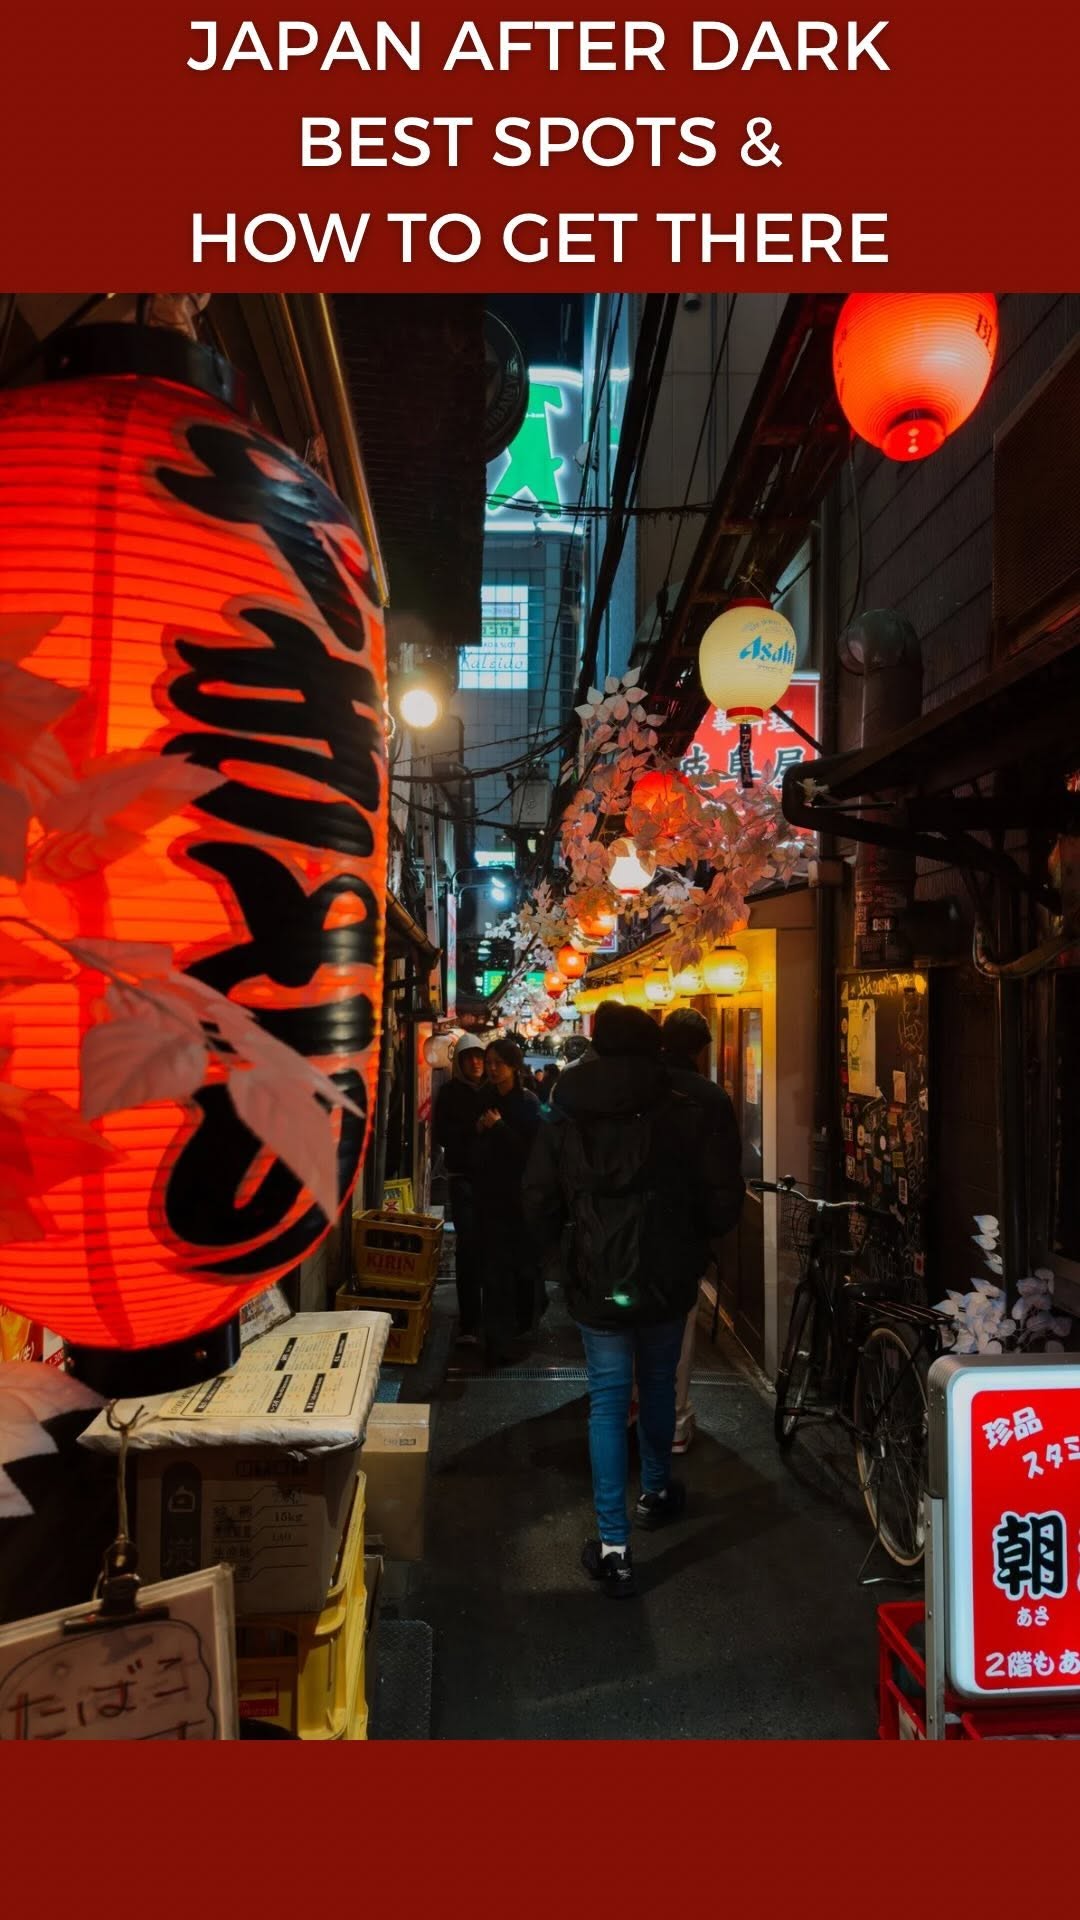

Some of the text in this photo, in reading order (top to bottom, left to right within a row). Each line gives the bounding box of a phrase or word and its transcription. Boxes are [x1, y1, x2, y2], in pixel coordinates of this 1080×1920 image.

[738, 634, 795, 665] Asahi
[367, 1253, 417, 1273] KIRIN
[982, 1406, 1043, 1451] 珍品
[1022, 1436, 1080, 1480] スタミ
[991, 1511, 1080, 1600] 朝
[1016, 1606, 1050, 1627] あさ
[8, 1658, 191, 1741] たばこ
